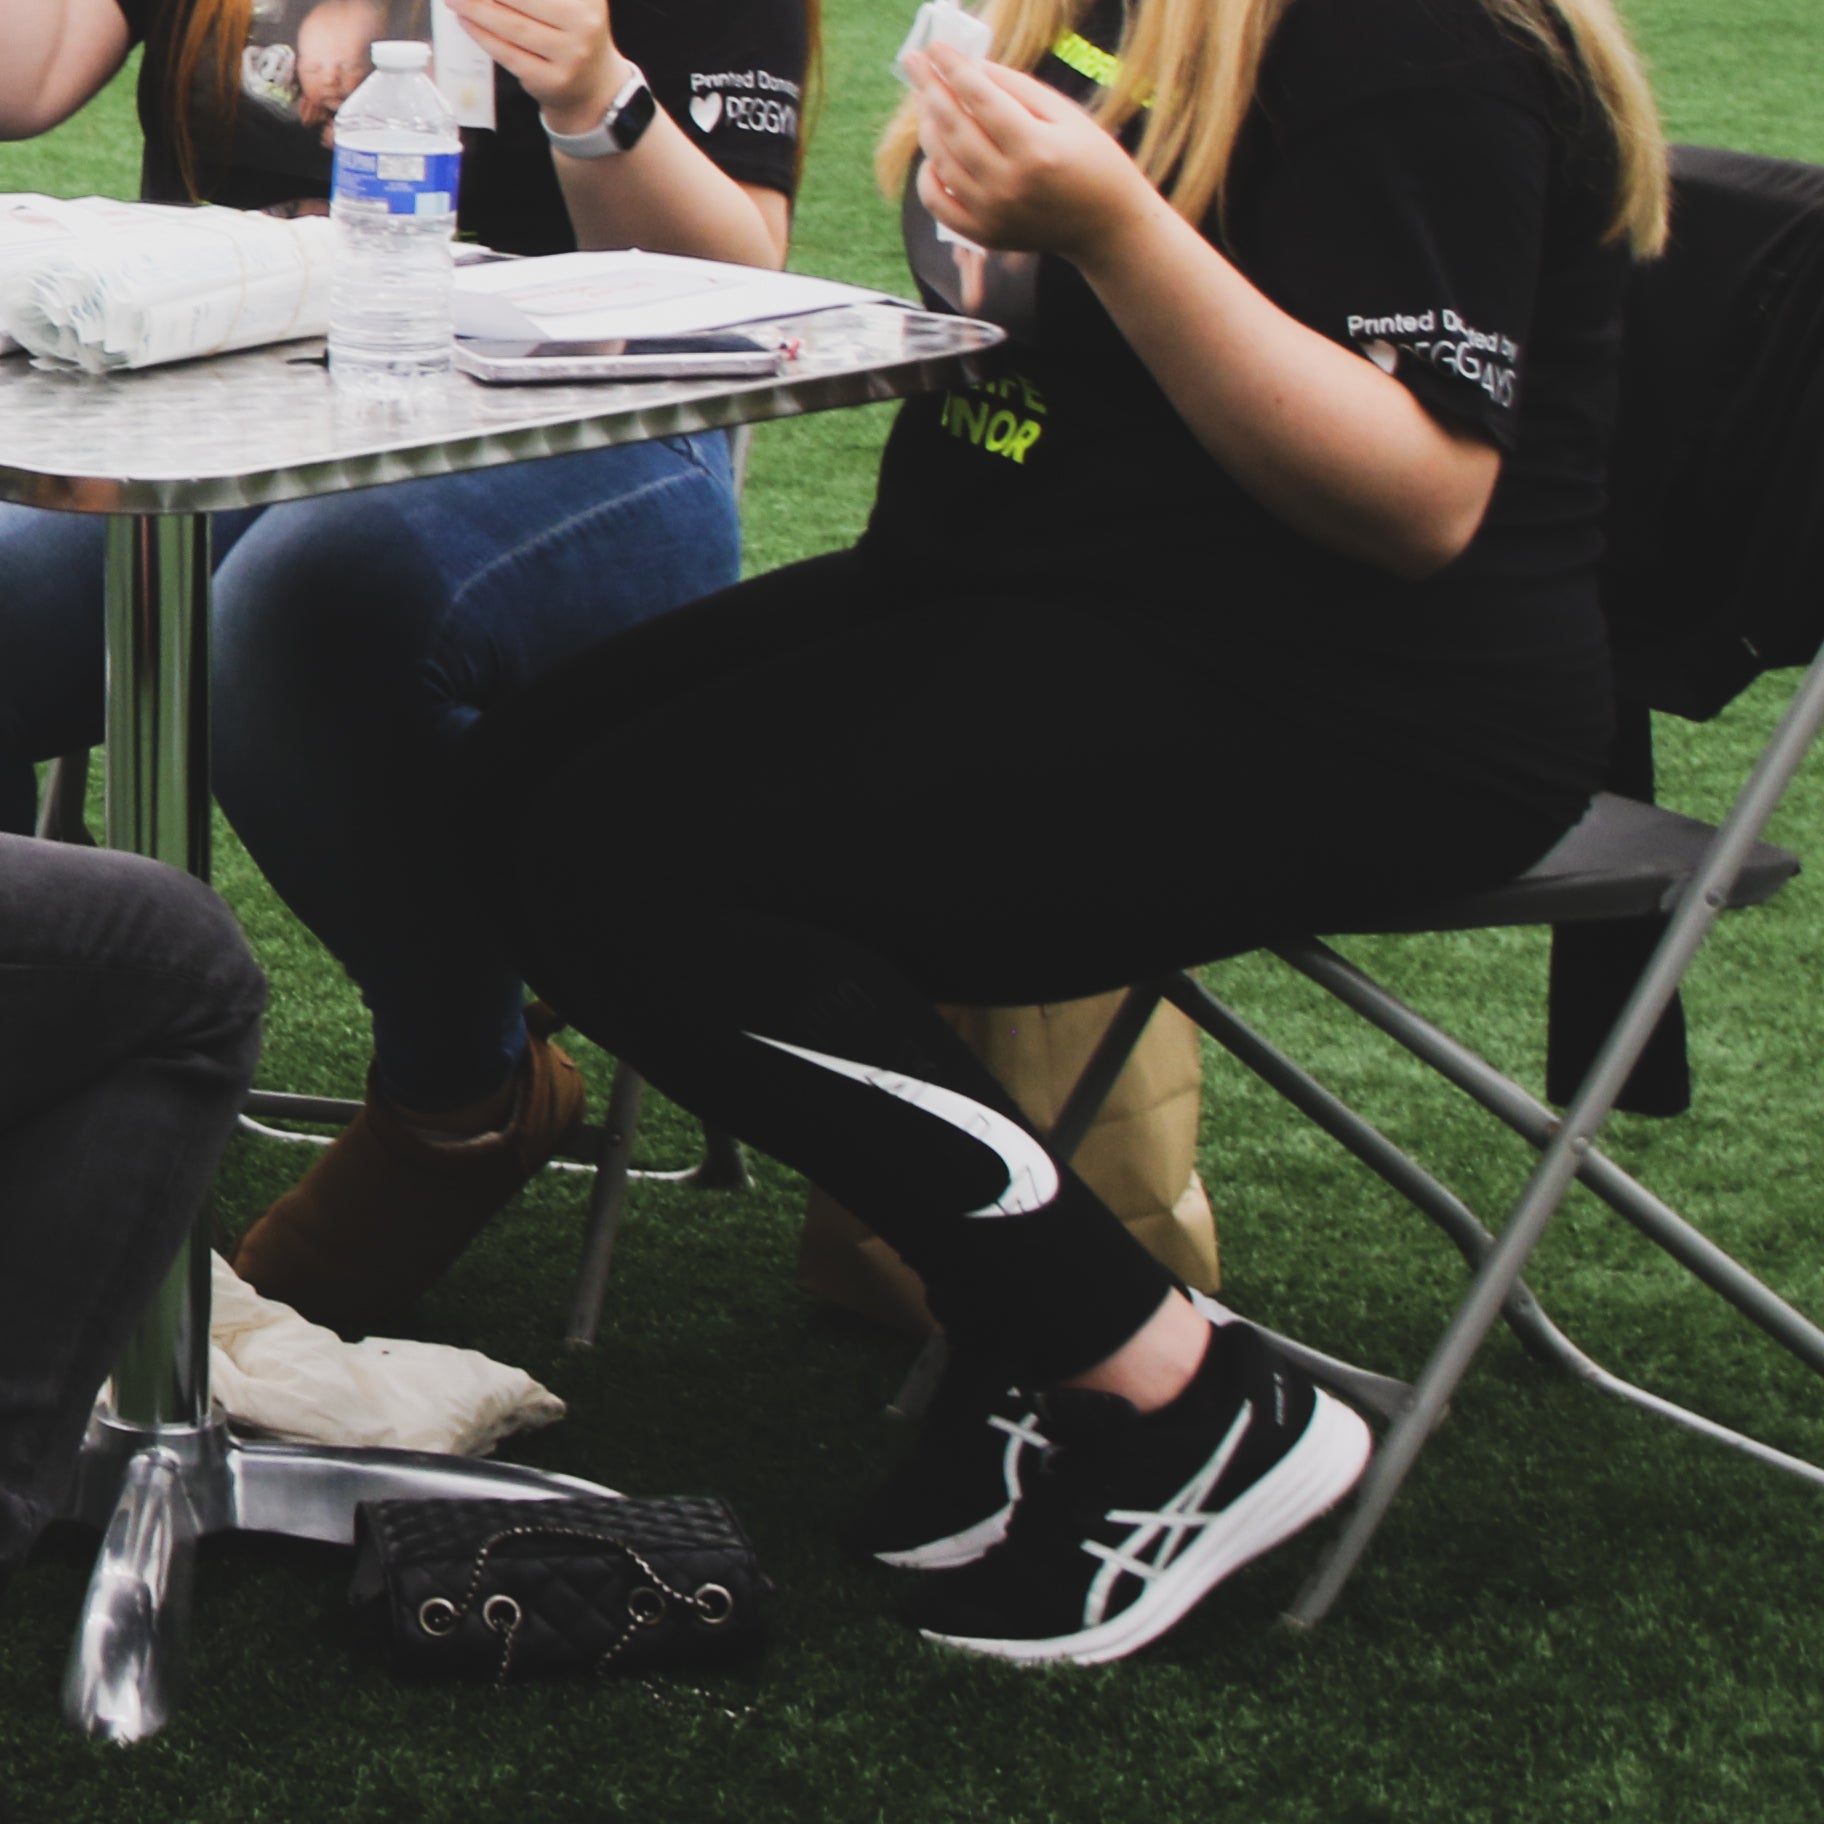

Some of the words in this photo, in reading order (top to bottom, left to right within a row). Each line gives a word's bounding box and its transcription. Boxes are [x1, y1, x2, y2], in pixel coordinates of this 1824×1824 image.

[690, 69, 755, 92] Printed
[1347, 309, 1435, 338] Printed
[941, 391, 1042, 465] NOR
